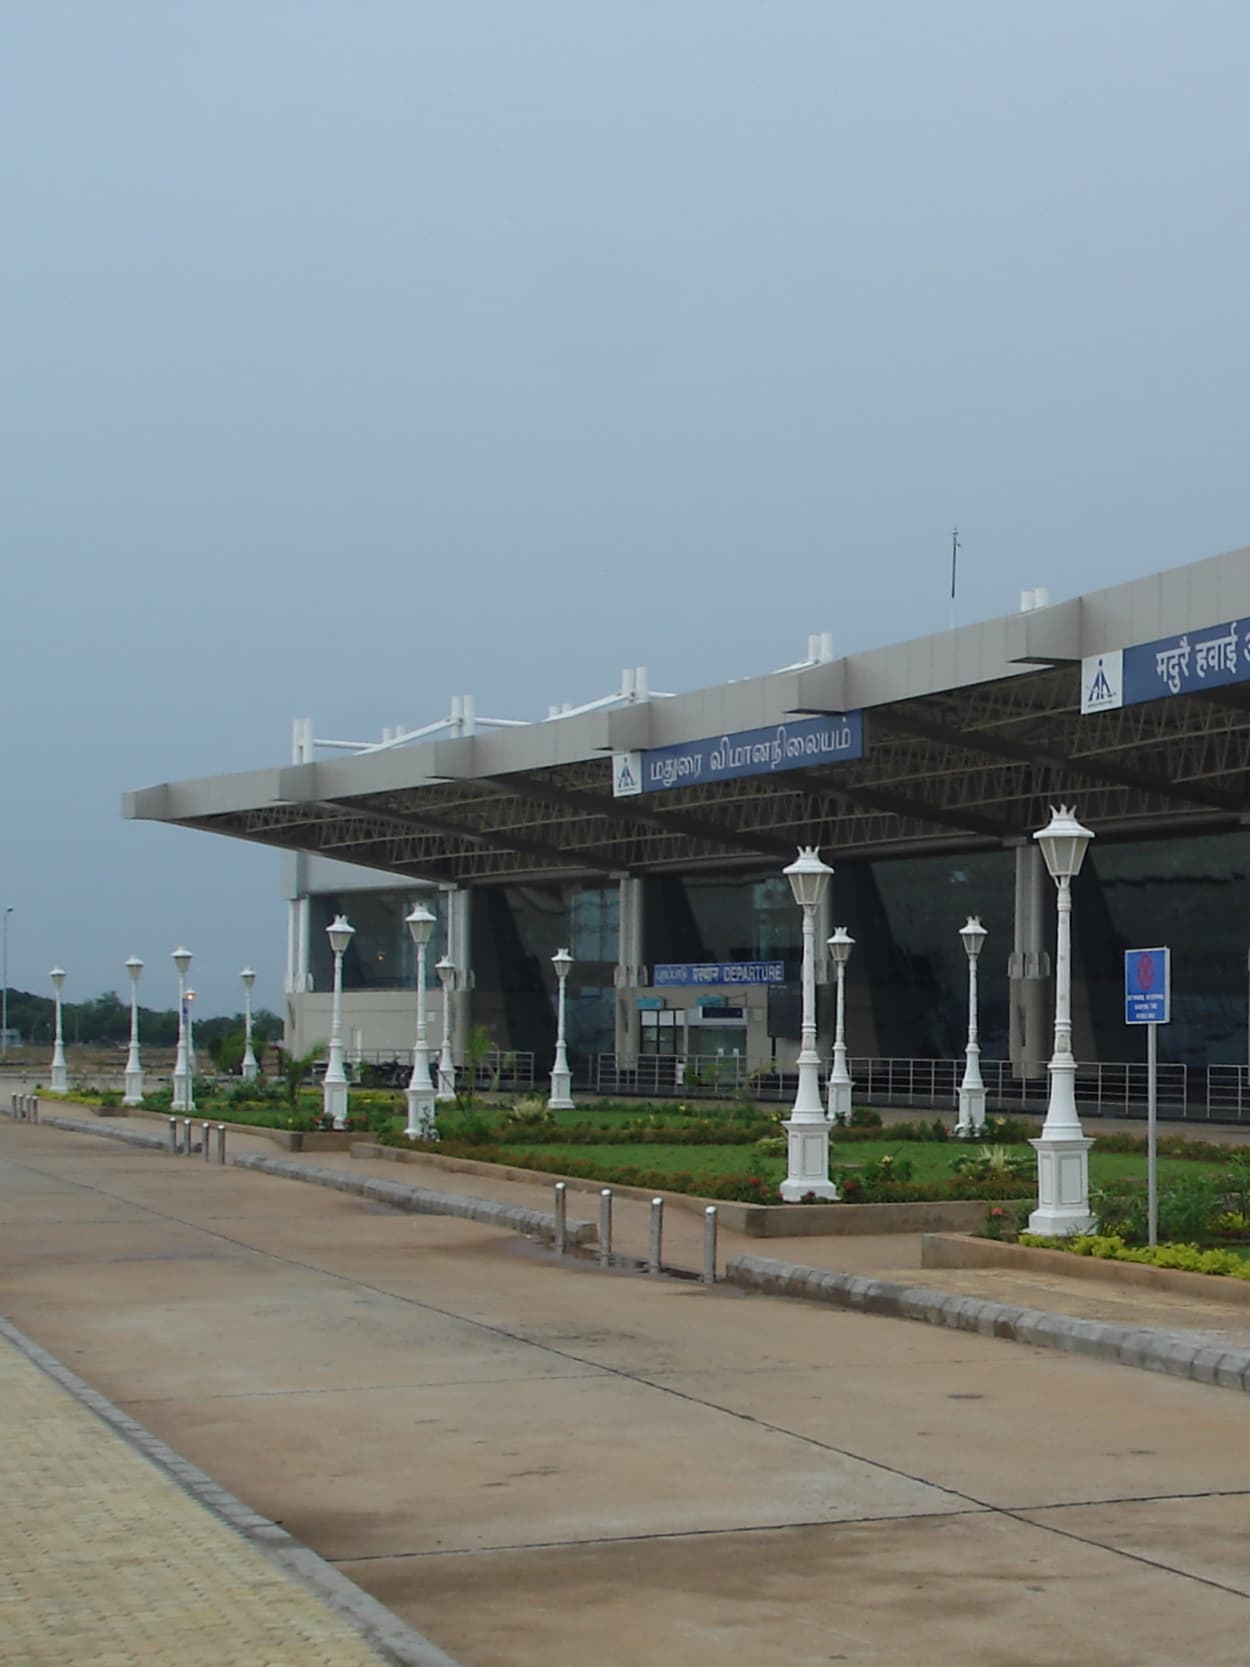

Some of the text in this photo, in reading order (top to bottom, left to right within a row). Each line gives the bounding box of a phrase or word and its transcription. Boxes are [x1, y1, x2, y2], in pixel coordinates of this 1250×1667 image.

[1156, 636, 1190, 693] मदुरै
[1195, 621, 1239, 678] हवाई
[650, 754, 702, 786] மதுரை
[723, 964, 784, 983] DEPARTURE
